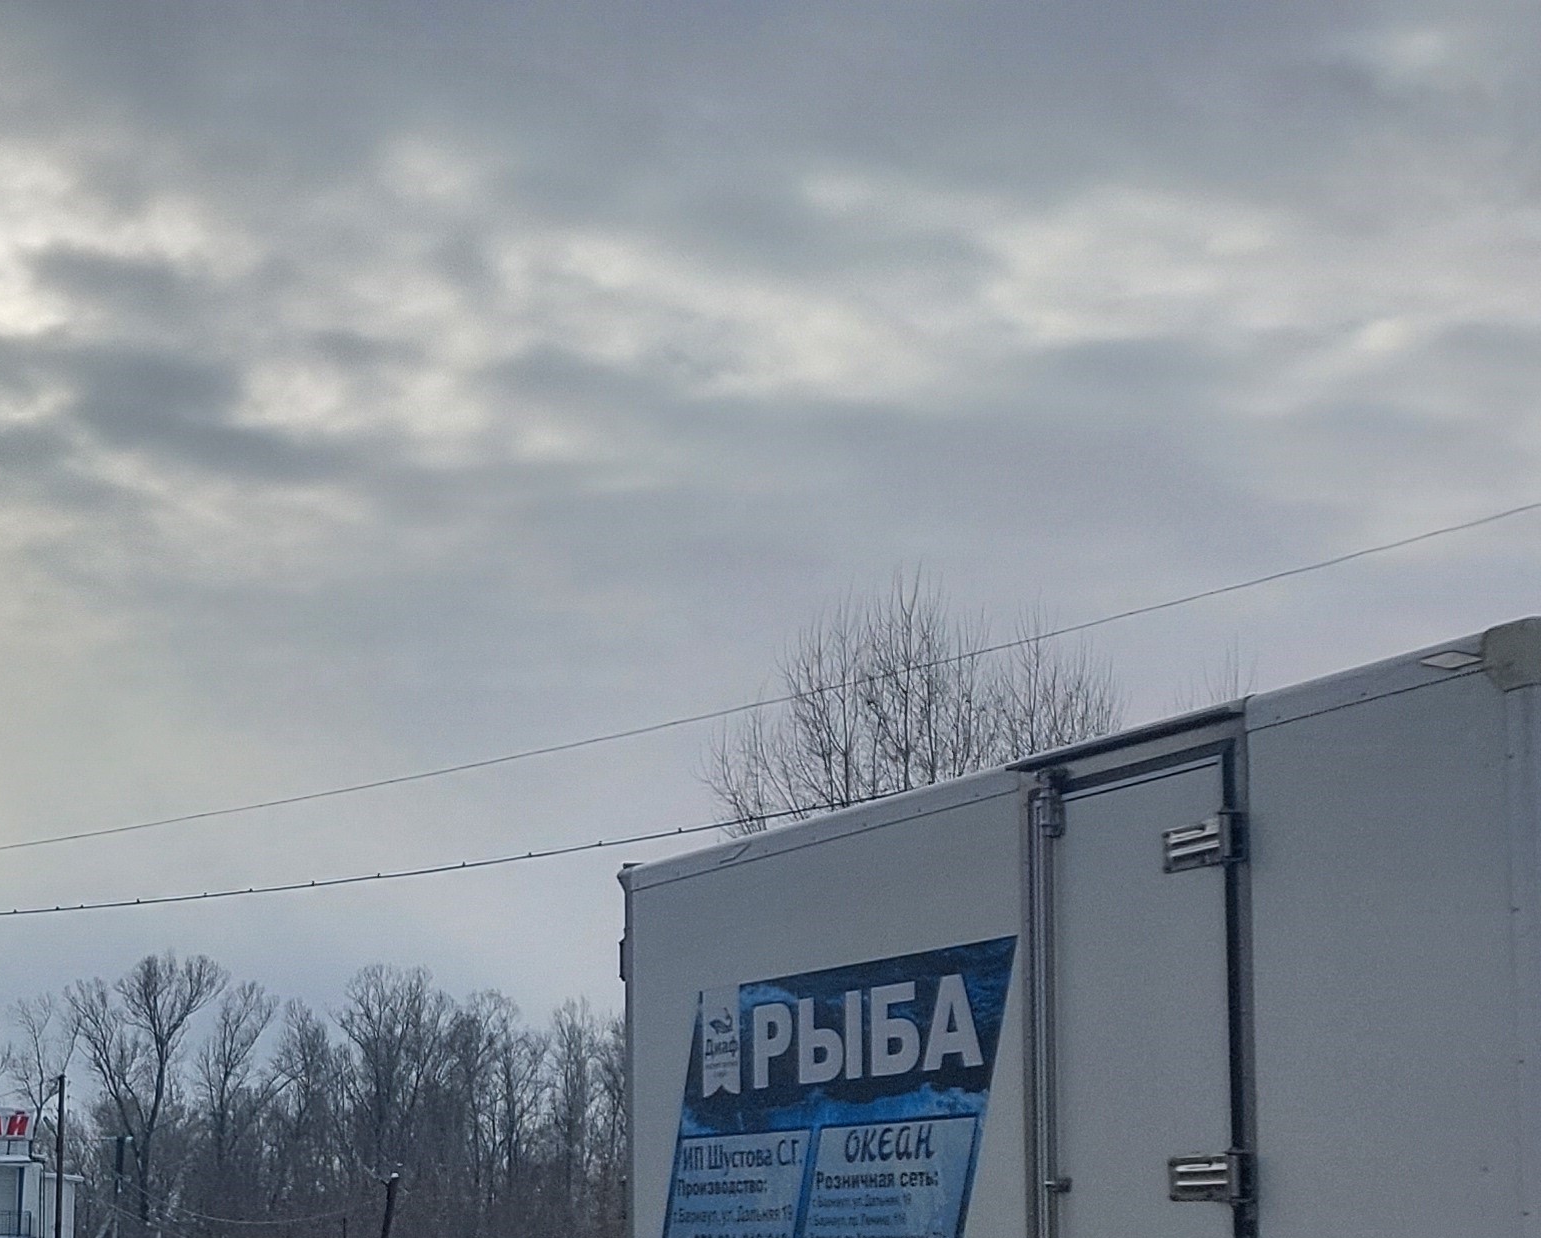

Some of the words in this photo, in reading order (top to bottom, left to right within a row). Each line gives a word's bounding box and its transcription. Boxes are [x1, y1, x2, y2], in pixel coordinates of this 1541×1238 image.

[752, 974, 984, 1089] РЫБА
[683, 1146, 704, 1171] ИП
[708, 1144, 773, 1176] Шустова
[677, 1179, 767, 1198] Производство:
[816, 1170, 895, 1190] Розничная
[900, 1170, 939, 1188] сеть:
